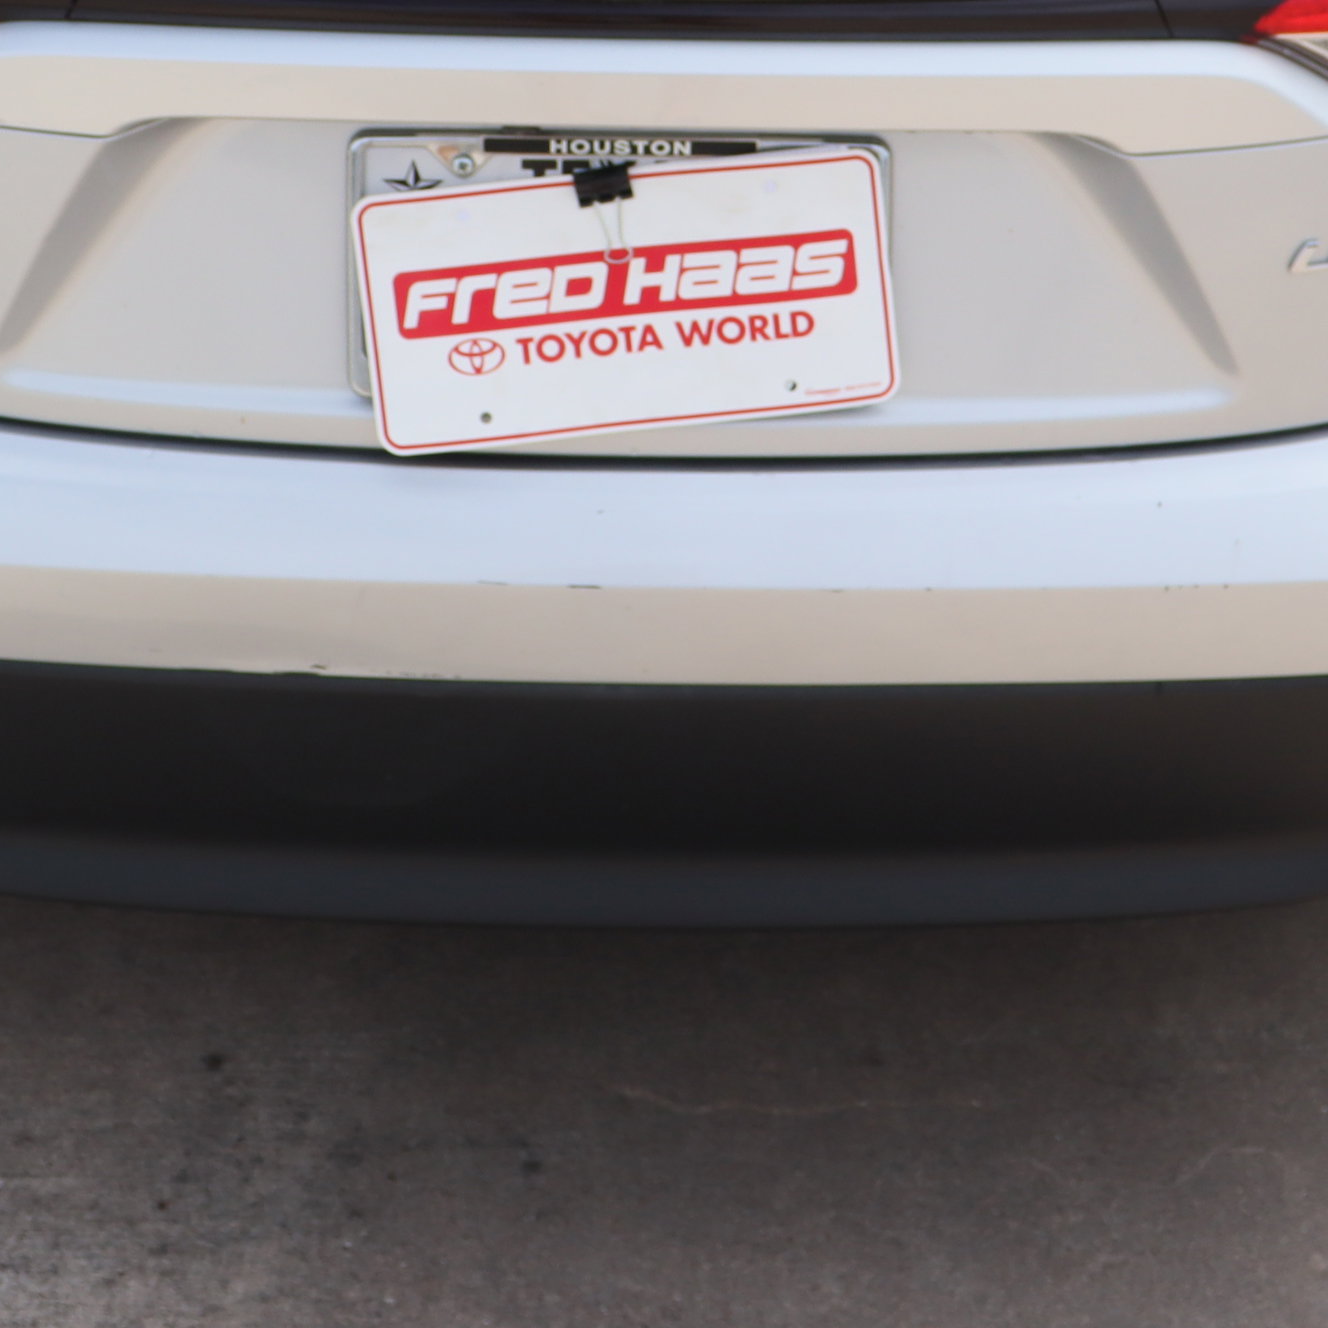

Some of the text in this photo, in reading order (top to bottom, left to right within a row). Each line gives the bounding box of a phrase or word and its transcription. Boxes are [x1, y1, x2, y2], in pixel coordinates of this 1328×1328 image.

[548, 138, 693, 156] HOUSTON
[516, 310, 816, 366] TOYOTA WORLD
